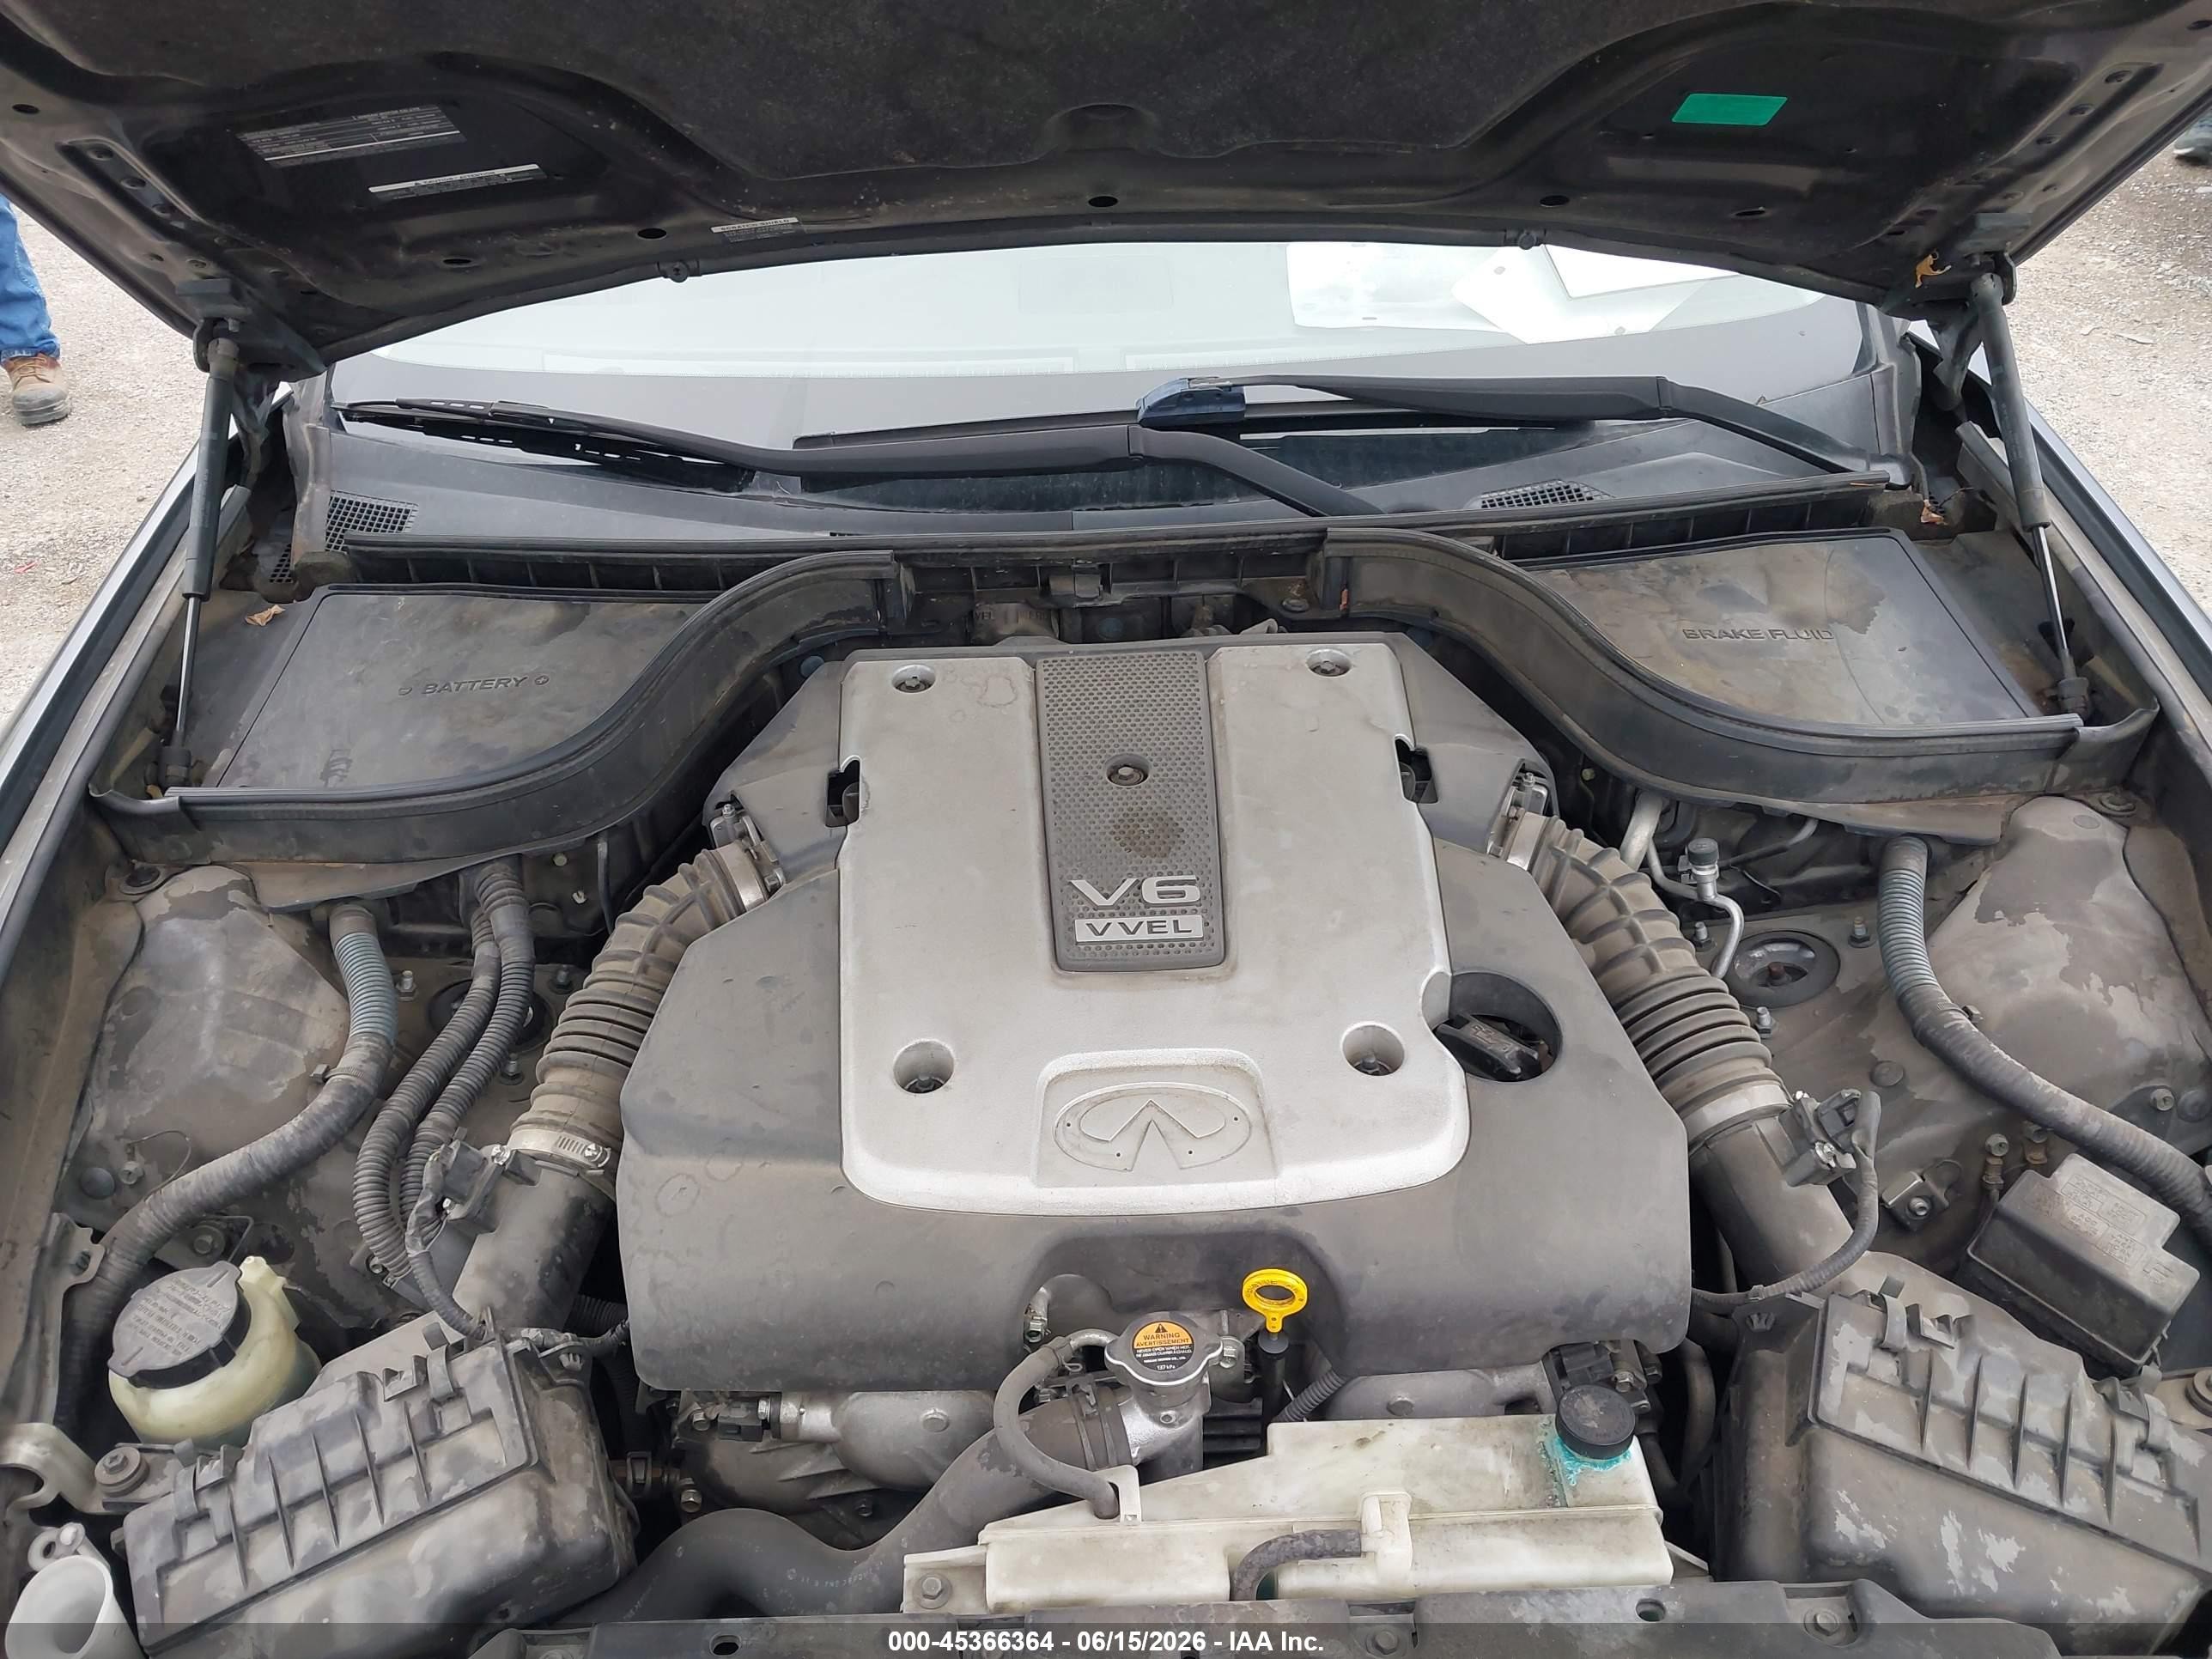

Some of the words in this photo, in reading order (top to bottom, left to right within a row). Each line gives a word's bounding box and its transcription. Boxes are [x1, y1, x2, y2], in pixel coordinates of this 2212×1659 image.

[1682, 629, 1765, 640] BRAKE
[1767, 629, 1835, 640] FLUID
[422, 676, 528, 695] BATTERY
[1069, 875, 1201, 908] V6
[1085, 919, 1193, 937] VVEL
[1136, 1338, 1189, 1347] AVERTISSEMENT
[1144, 1332, 1180, 1340] WARNING
